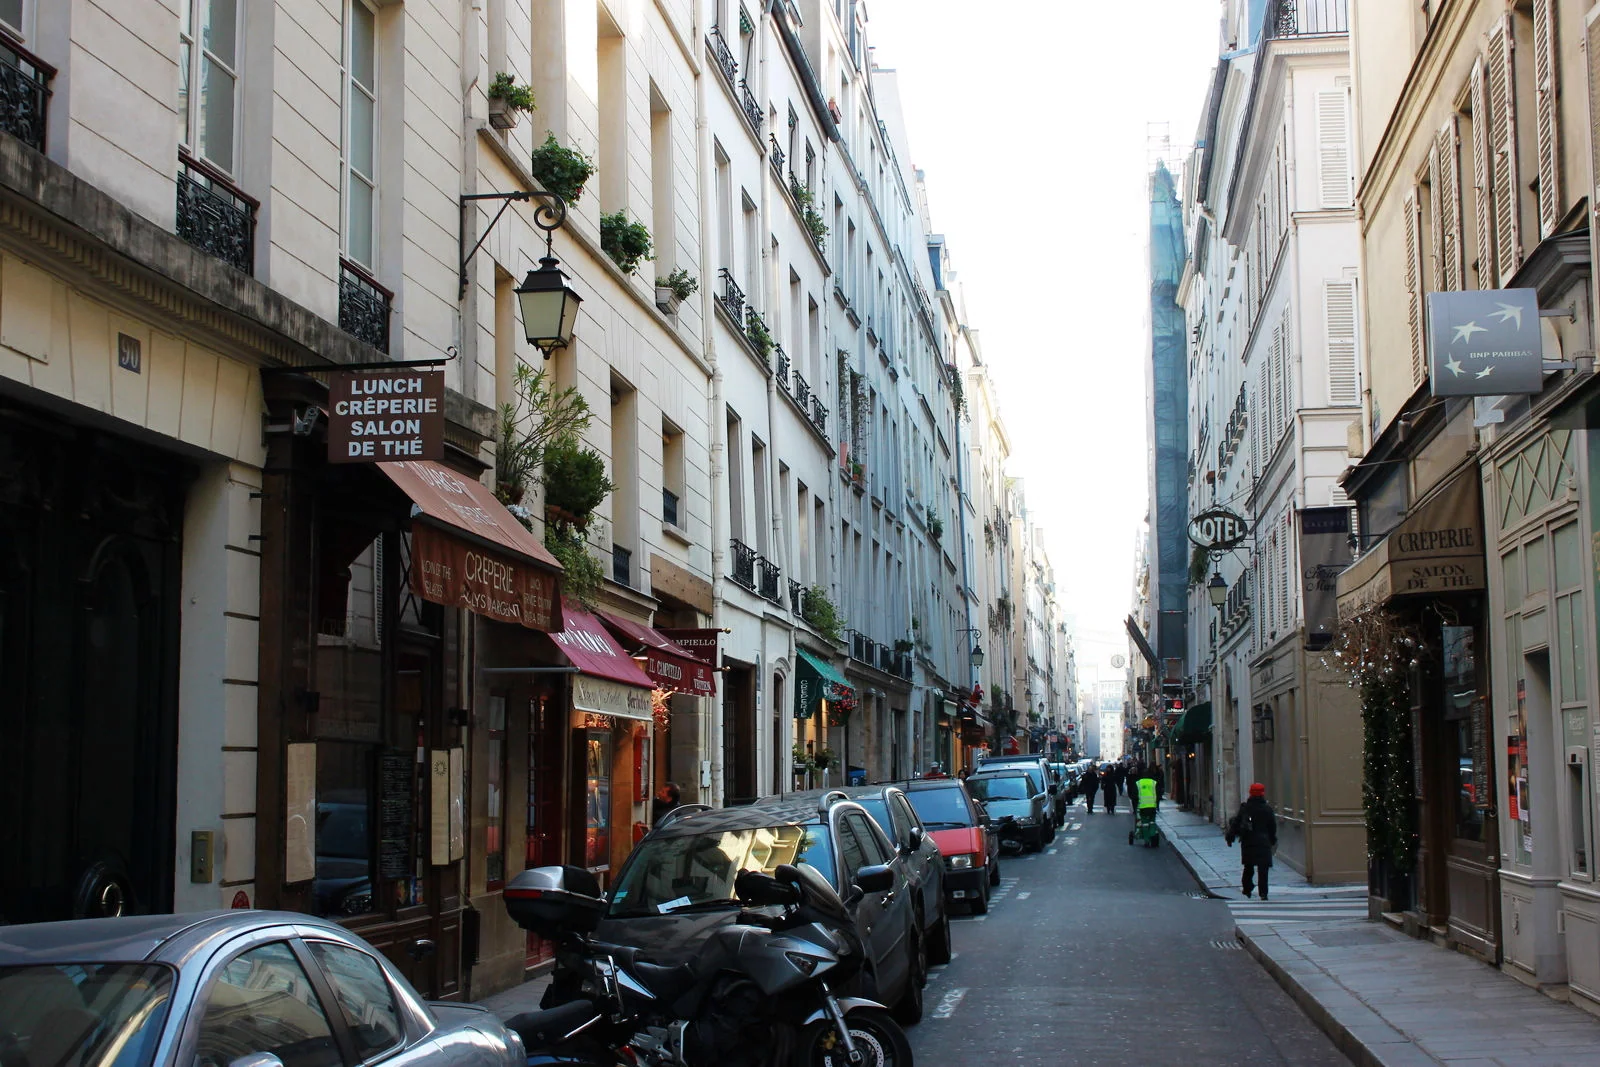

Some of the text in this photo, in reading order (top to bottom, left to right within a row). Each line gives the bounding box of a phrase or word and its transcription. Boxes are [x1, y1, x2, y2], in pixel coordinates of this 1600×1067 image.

[122, 337, 139, 369] 90
[1492, 350, 1534, 358] PARIBAS
[351, 378, 422, 395] LUNCH
[335, 397, 437, 416] CRÊPERIE
[350, 420, 420, 436] SALON
[348, 436, 423, 457] DE THÉ
[1412, 563, 1466, 579] SALON
[1407, 578, 1429, 591] DE
[471, 592, 487, 609] LYS
